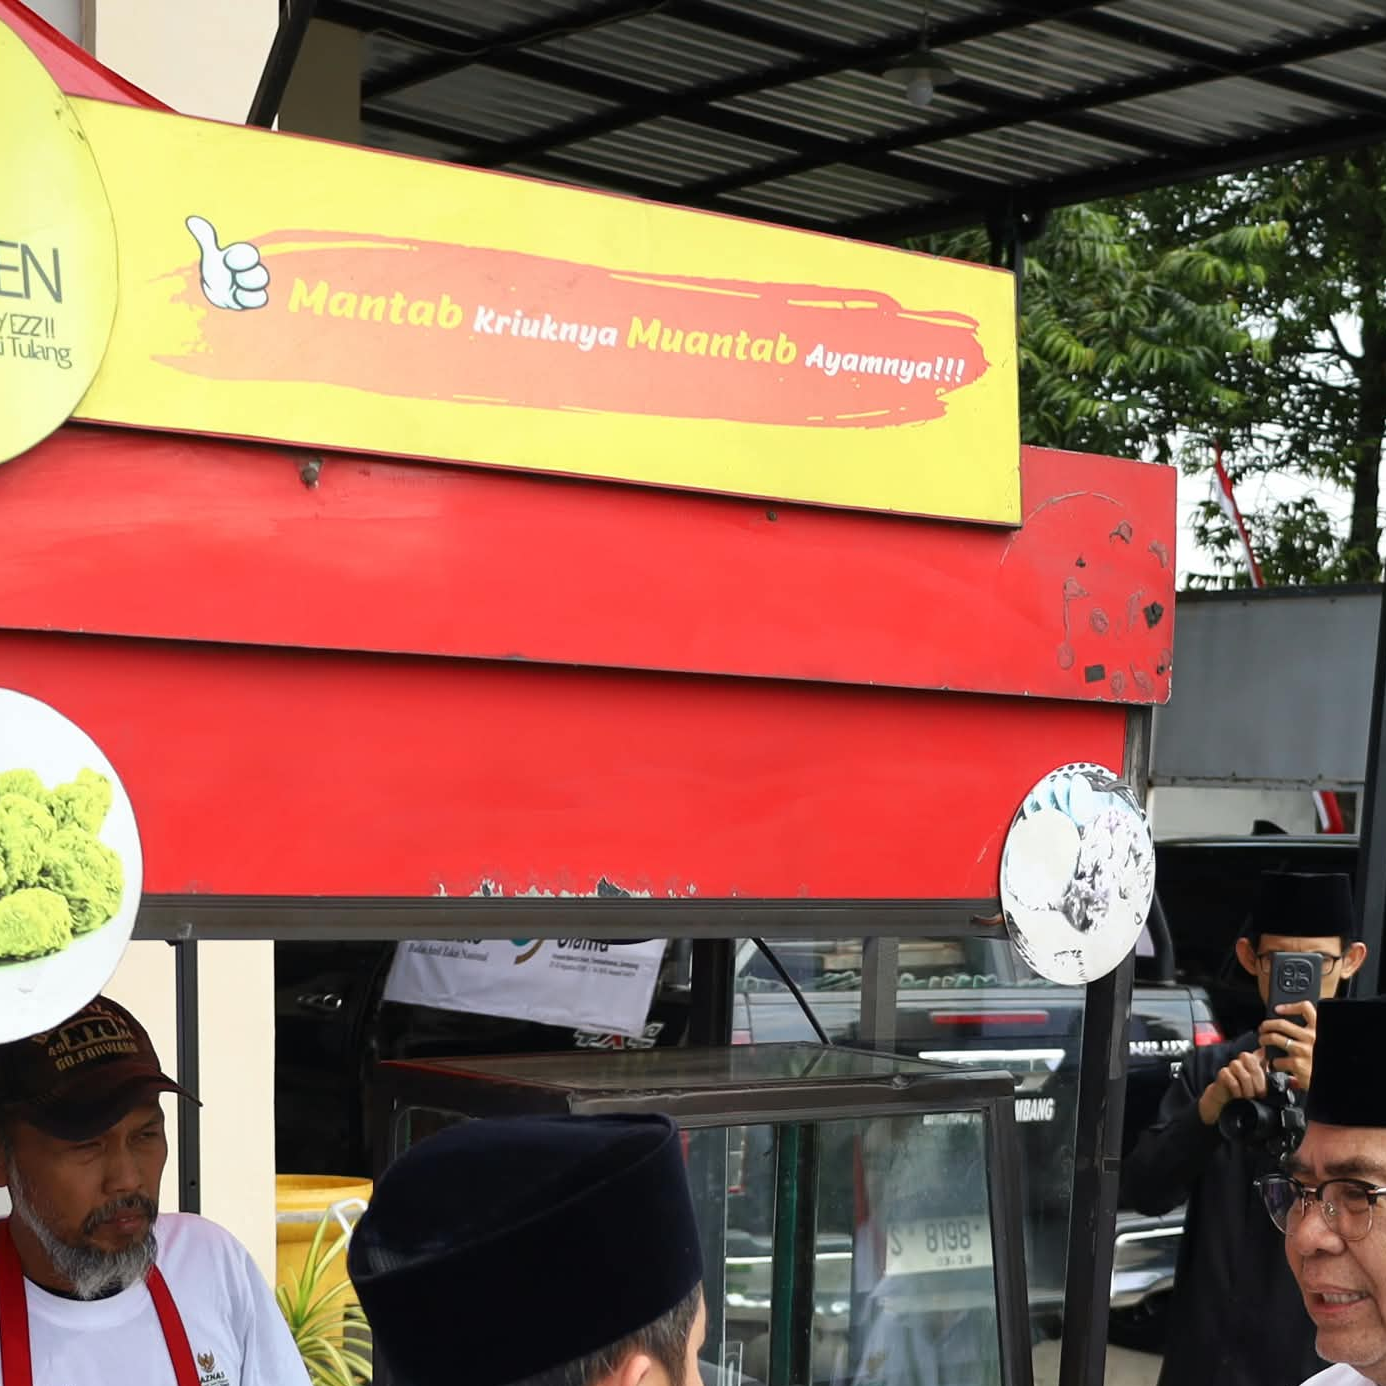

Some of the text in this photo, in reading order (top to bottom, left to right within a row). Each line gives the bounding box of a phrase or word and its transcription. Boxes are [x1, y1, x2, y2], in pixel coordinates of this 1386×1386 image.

[288, 278, 965, 384] Mantab Kriuknya Muantab Ayamnya!!!
[10, 335, 73, 370] Tulang
[1014, 1098, 1055, 1122] MBANG
[925, 1220, 971, 1253] 8198
[200, 1372, 225, 1384] AZNAS
